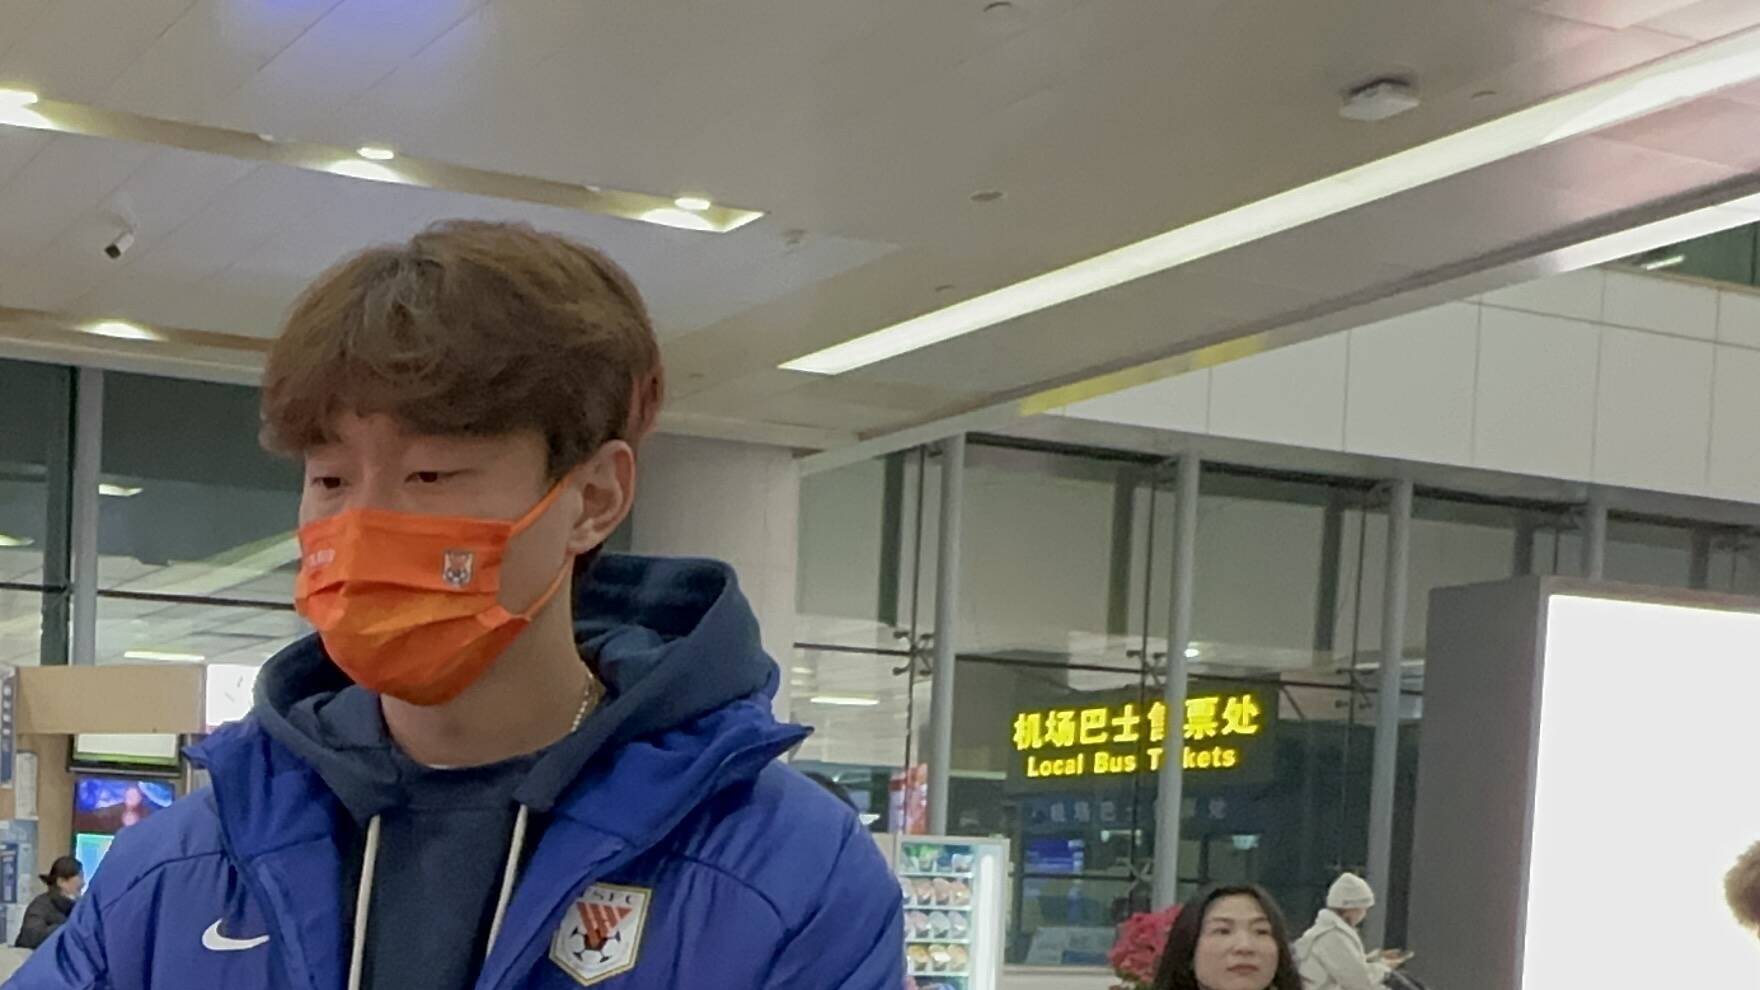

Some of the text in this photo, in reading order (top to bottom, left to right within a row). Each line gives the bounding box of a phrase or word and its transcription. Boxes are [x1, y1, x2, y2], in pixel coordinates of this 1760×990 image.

[1026, 747, 1236, 778] Local Bus Tkets
